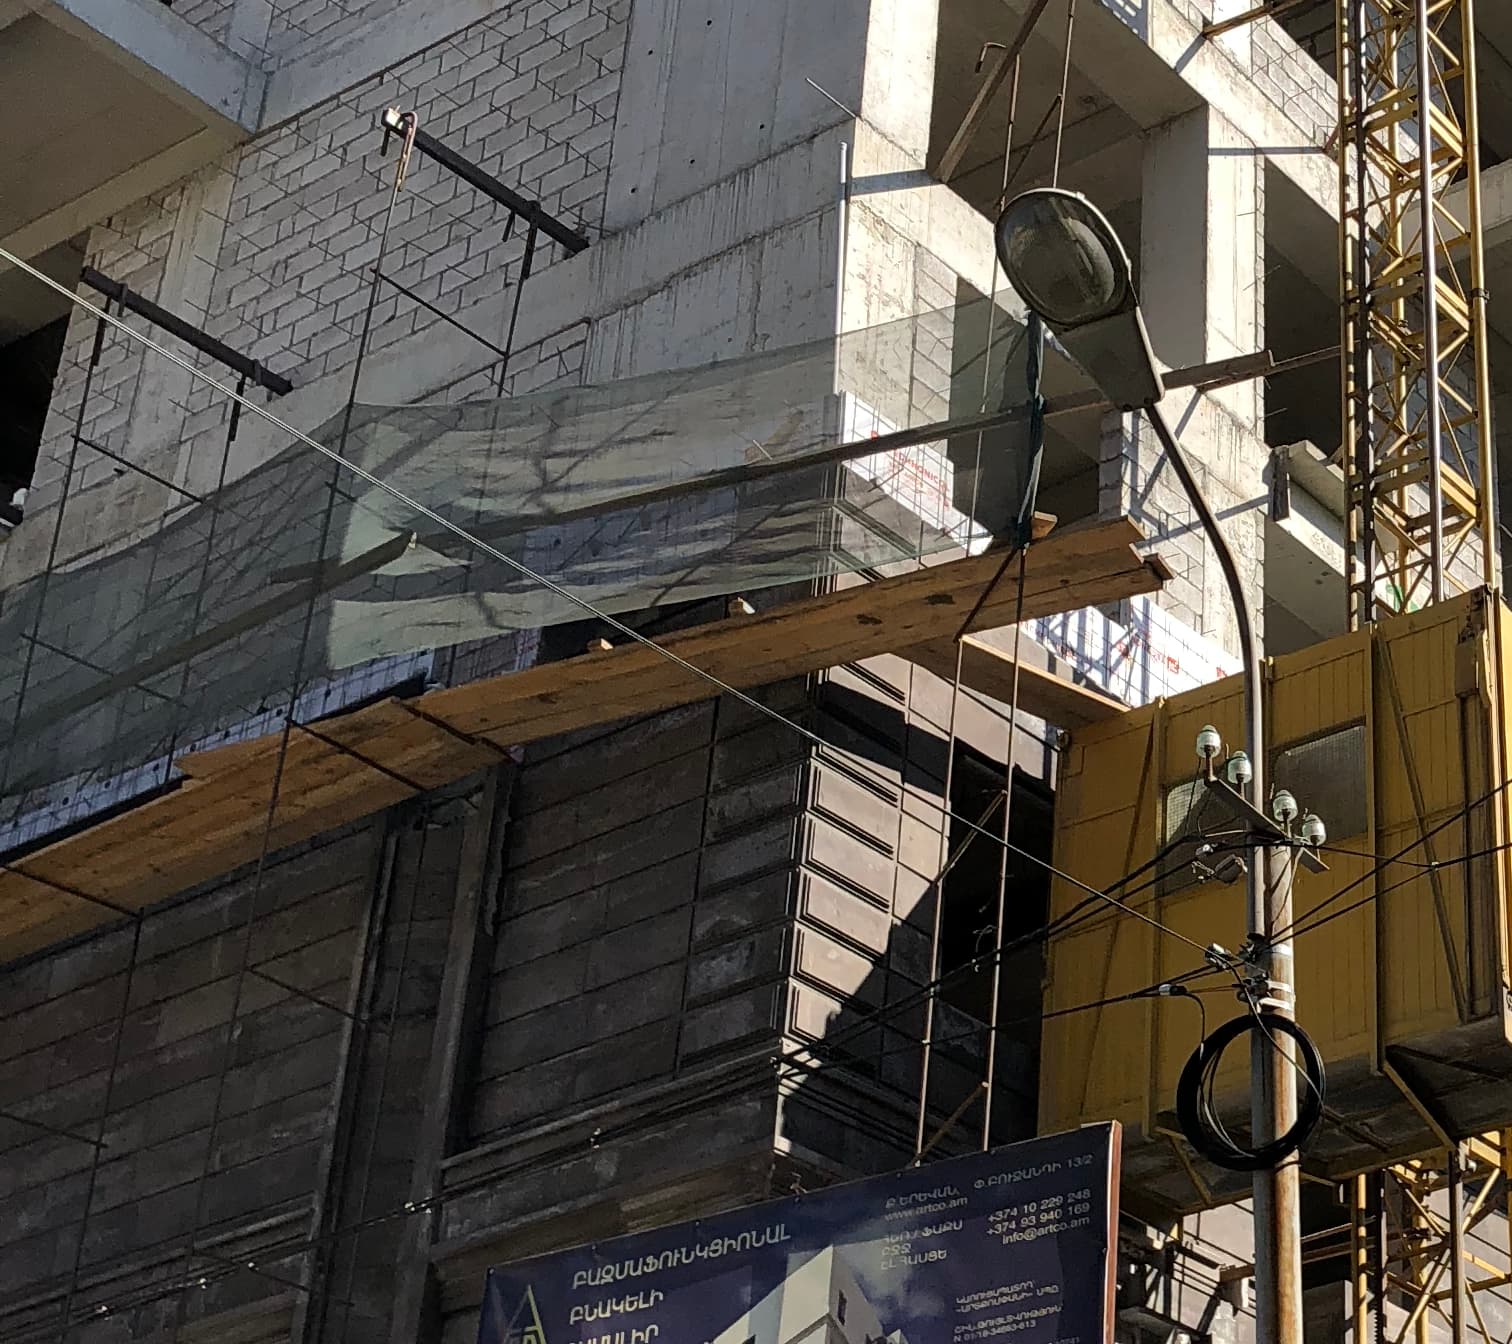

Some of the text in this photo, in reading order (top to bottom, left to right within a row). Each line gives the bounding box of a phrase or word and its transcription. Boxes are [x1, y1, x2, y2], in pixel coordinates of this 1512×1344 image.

[884, 1197, 968, 1221] www.artco.am
[986, 1220, 1016, 1235] +374
[1020, 1215, 1036, 1227] 93
[1040, 1209, 1063, 1223] 940
[1068, 1202, 1090, 1215] 169
[988, 1207, 1017, 1222] +374
[1023, 1202, 1037, 1213] 10
[1040, 1195, 1063, 1209] 229
[1067, 1189, 1090, 1203] 248
[1002, 1217, 1090, 1245] info@artco.am
[571, 1223, 791, 1290] ԲԱԶՄԱՖՈՒՆԿՑԻՈՆԱԼ
[569, 1289, 664, 1325] ԲՆԱԿԵԼԻ
